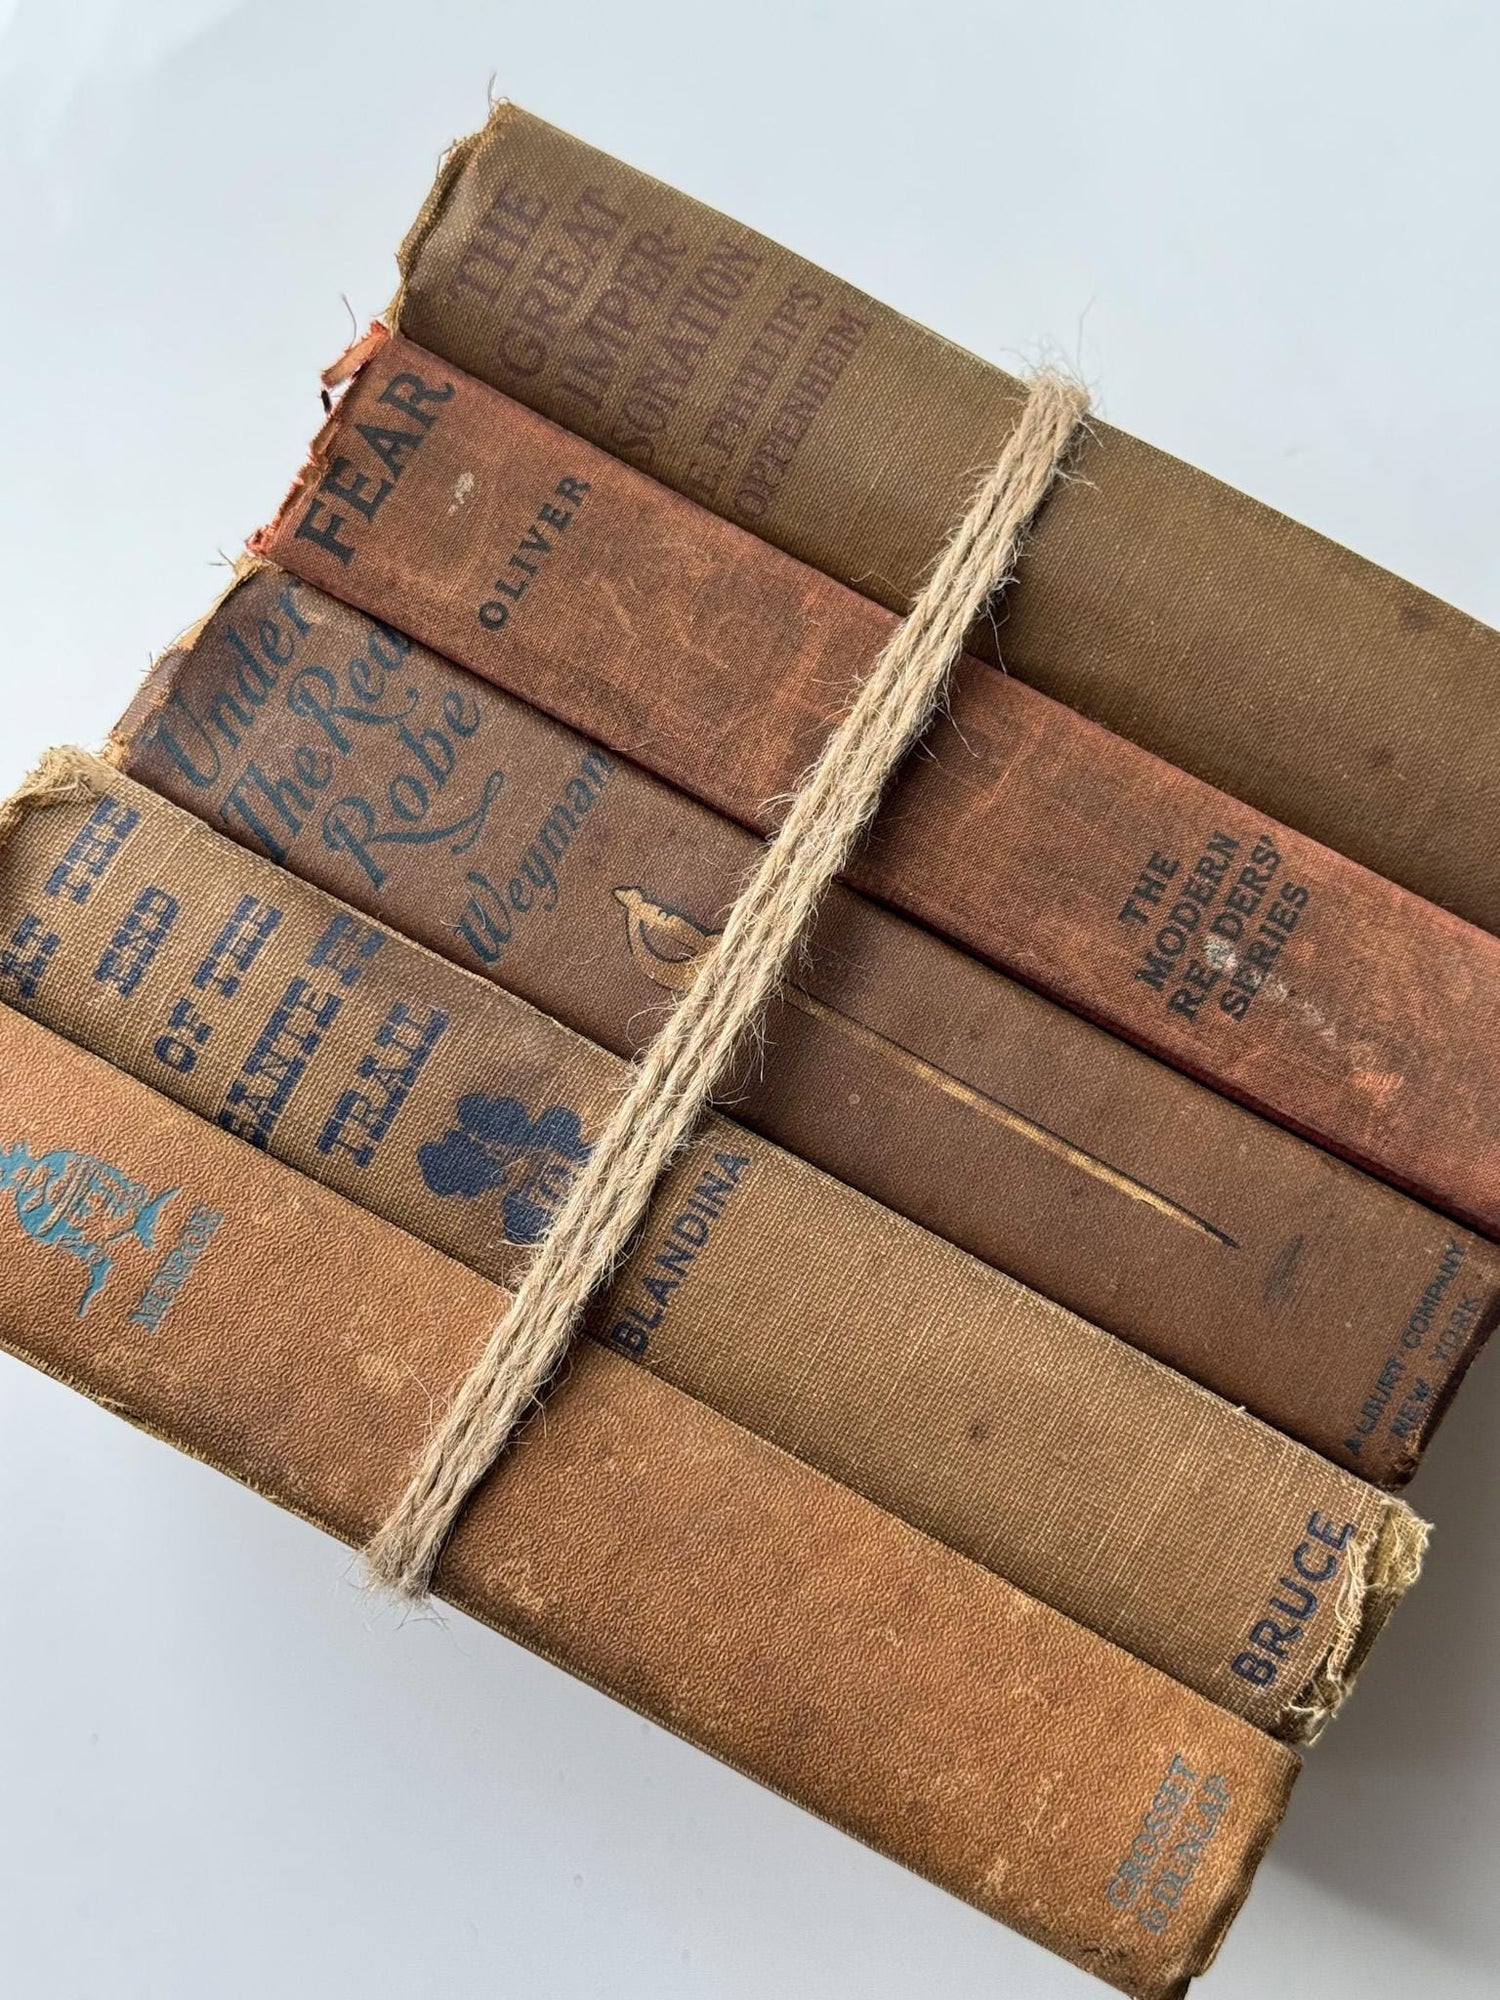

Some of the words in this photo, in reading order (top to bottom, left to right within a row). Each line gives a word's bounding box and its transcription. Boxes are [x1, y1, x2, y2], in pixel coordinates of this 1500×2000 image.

[450, 184, 552, 304] THE
[500, 184, 627, 379] GREAT
[611, 238, 762, 463] SONATION
[704, 282, 823, 461] PHILLIPS
[733, 308, 875, 522] OPPENHEIM
[294, 371, 456, 567] FEAR
[478, 475, 592, 632] OLIVER
[141, 580, 311, 790] Under
[44, 798, 141, 904] THE
[219, 743, 333, 863] The
[322, 686, 505, 893] Robe
[453, 745, 620, 967] Weyman
[94, 885, 180, 998] END
[1118, 851, 1181, 926] THE
[1134, 830, 1241, 992] MODERN
[1219, 882, 1310, 1023] SERIES
[153, 999, 214, 1075] OF
[192, 894, 283, 998] THE
[315, 1000, 449, 1169] TRAIL
[609, 1152, 750, 1358] BLANDINA
[1402, 1236, 1466, 1350] COMPANY
[1390, 1377, 1432, 1438] NEW
[1430, 1292, 1482, 1363] YORK
[1231, 1510, 1356, 1689] BRUCE
[1107, 1754, 1197, 1911] GROSSET
[1152, 1773, 1231, 1910] DUNLAP
